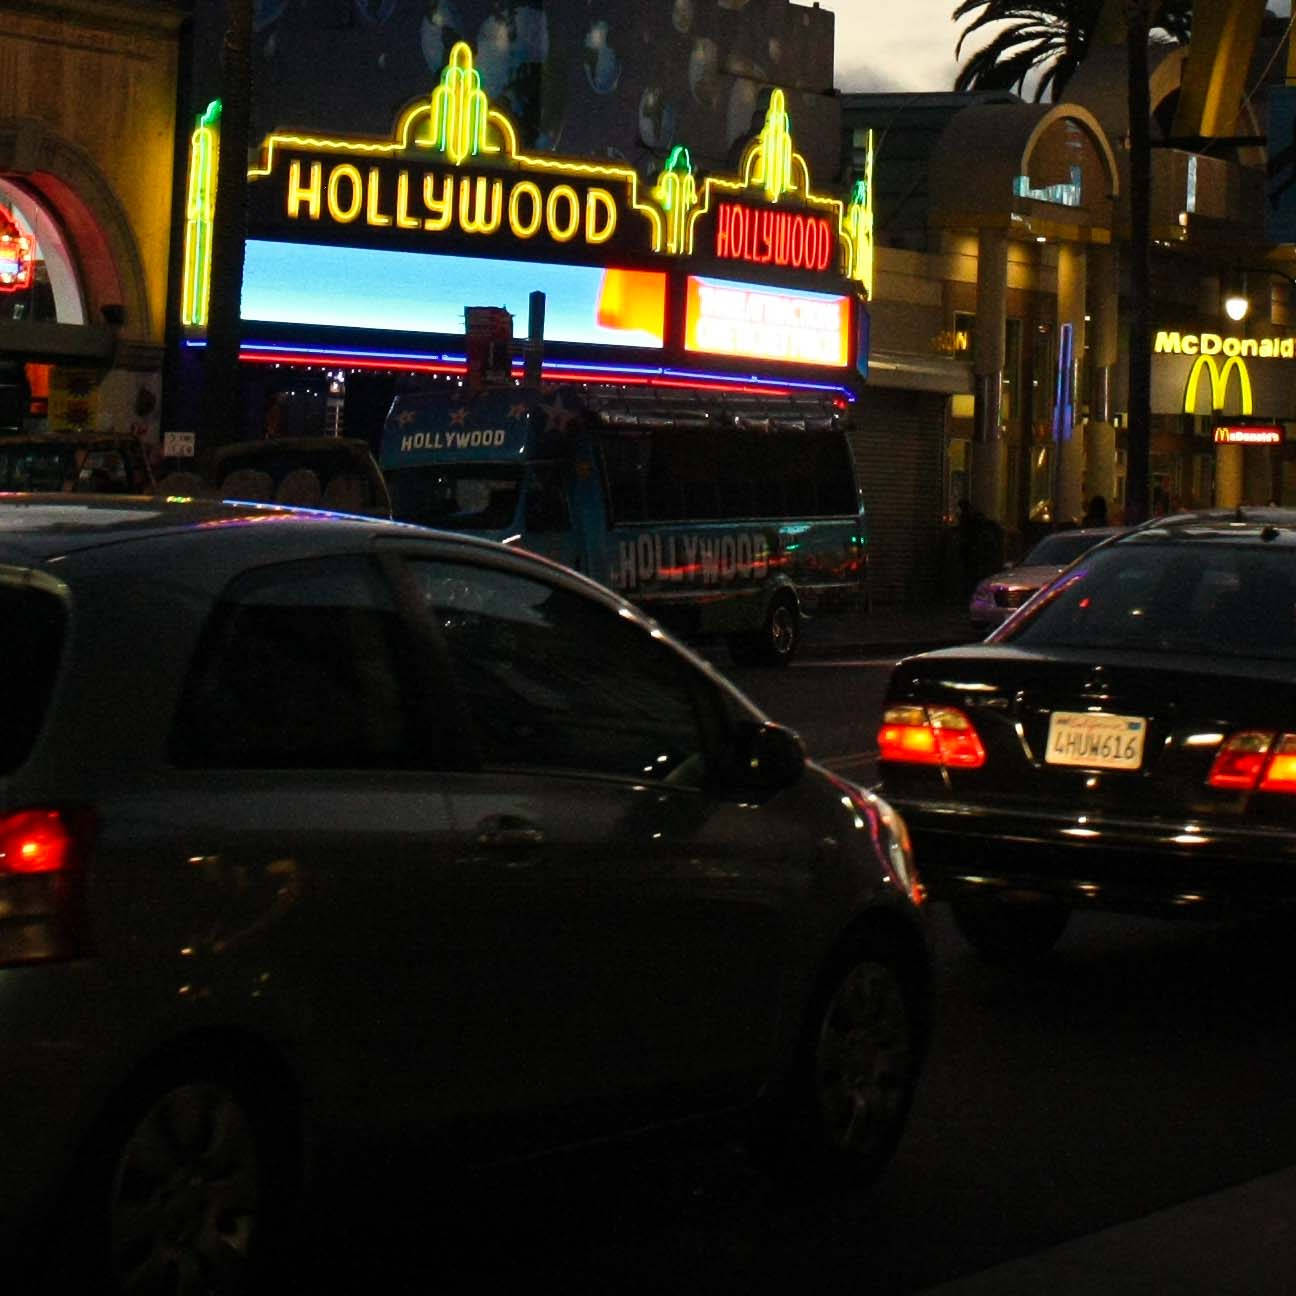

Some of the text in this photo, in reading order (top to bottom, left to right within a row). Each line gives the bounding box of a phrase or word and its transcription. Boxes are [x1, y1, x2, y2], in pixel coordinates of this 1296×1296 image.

[286, 158, 619, 246] HOLLYWOOD
[715, 203, 834, 272] HOLLYWOOD
[401, 430, 506, 452] HOLLYWOOD
[619, 533, 769, 590] HOLLYWOOD
